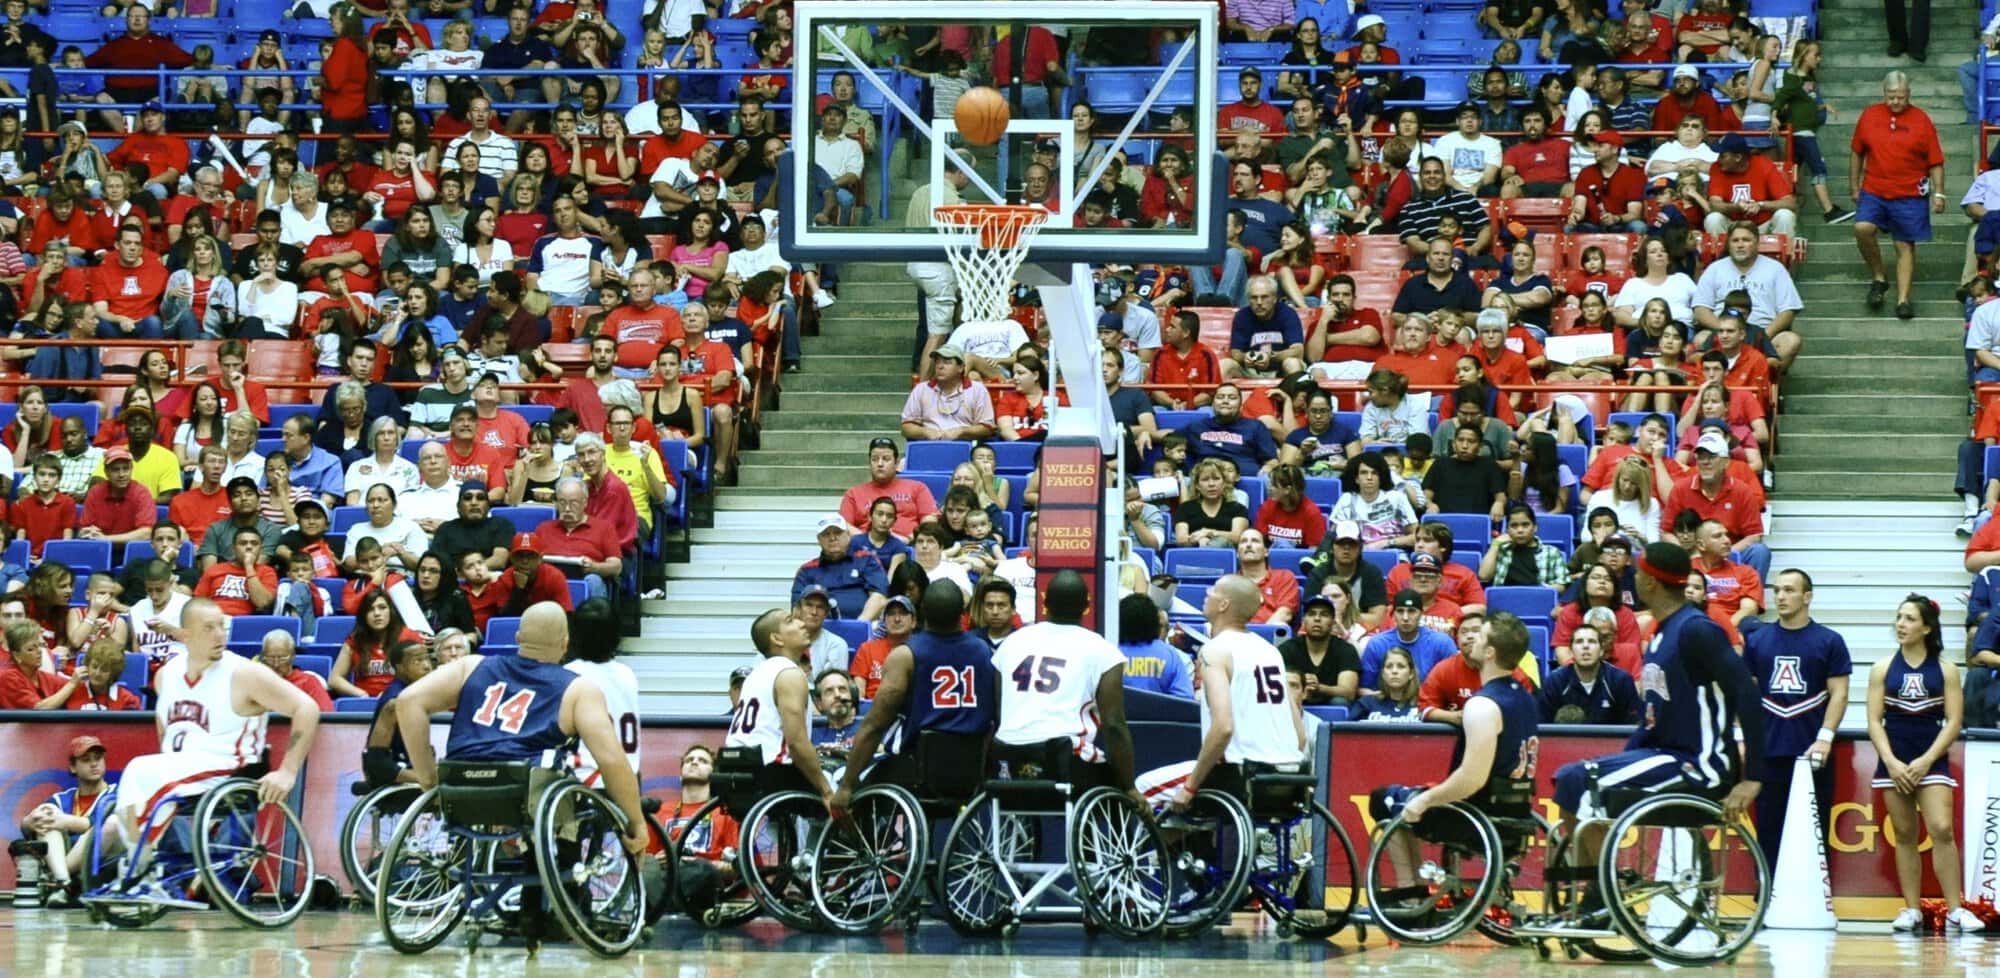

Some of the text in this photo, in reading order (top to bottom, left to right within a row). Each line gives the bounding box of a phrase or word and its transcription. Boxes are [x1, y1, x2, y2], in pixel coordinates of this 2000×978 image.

[1046, 464, 1095, 475] WELLS
[1046, 475, 1094, 487] FARGO
[1042, 527, 1091, 538] WELLS
[1042, 538, 1090, 550] FARGO
[215, 574, 250, 600] A
[932, 665, 978, 709] 21
[1012, 655, 1067, 694] 45
[1254, 665, 1285, 705] 15
[1770, 656, 1807, 694] A
[1897, 673, 1928, 700] A
[472, 682, 536, 734] 14
